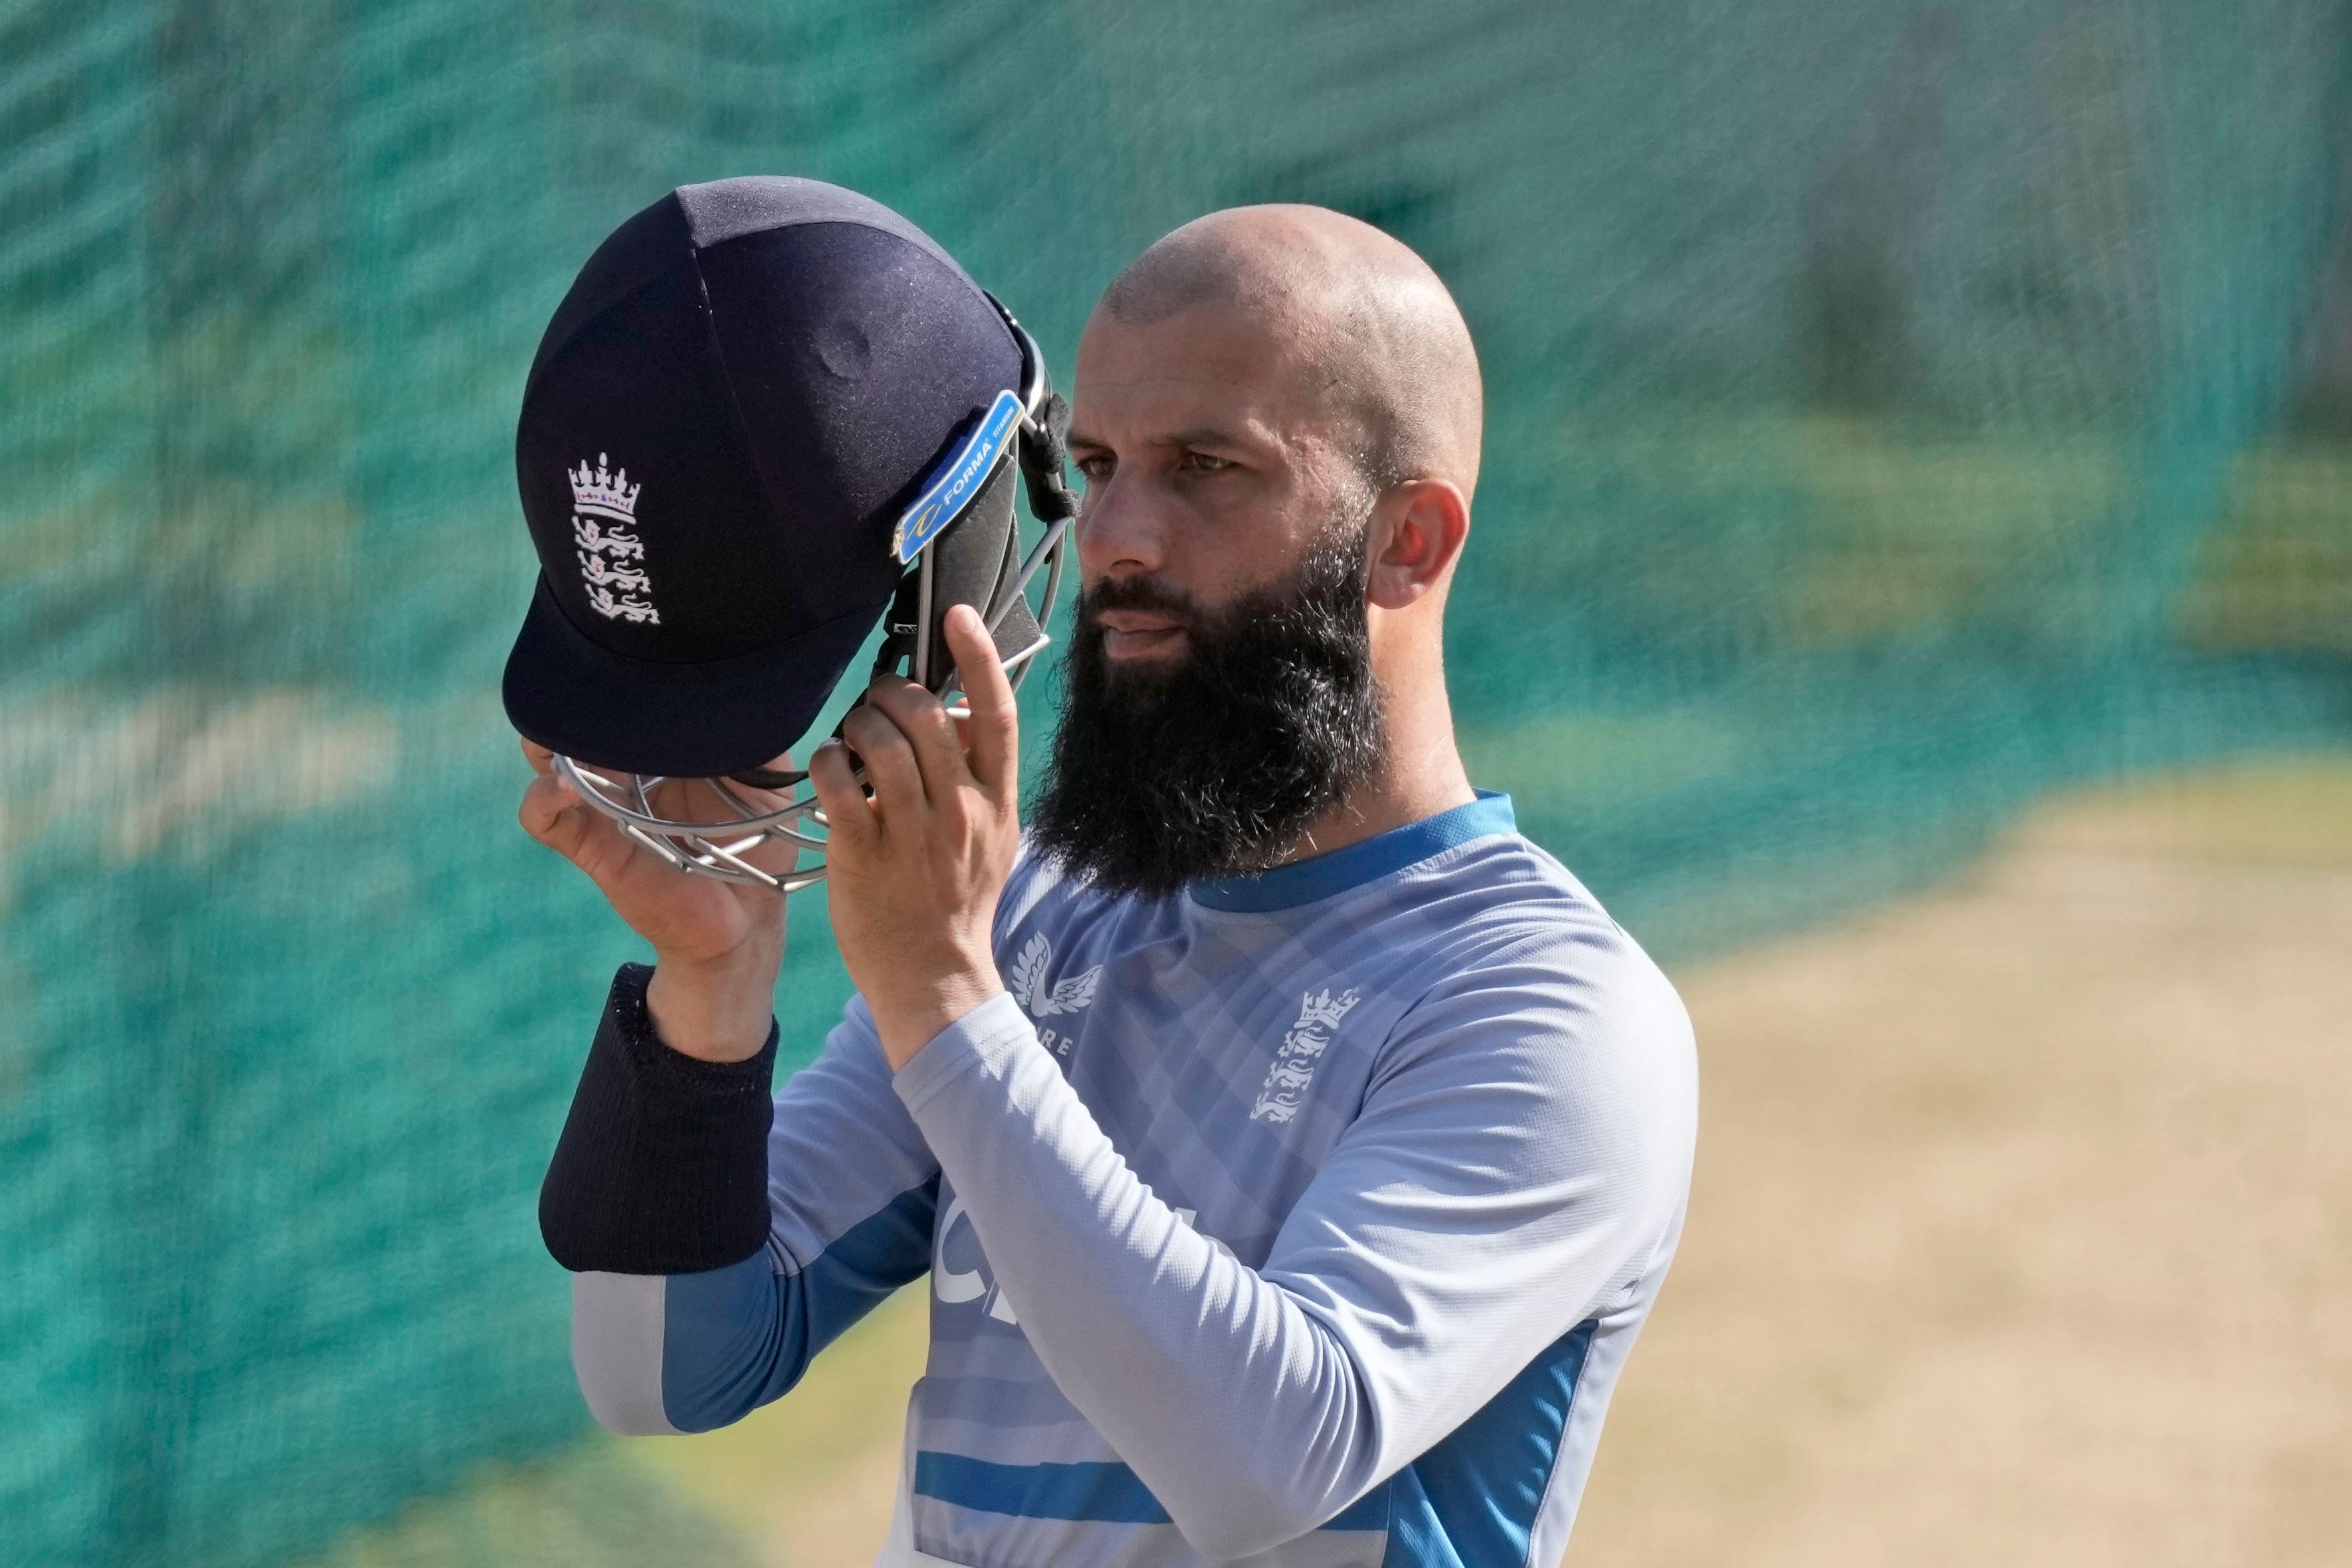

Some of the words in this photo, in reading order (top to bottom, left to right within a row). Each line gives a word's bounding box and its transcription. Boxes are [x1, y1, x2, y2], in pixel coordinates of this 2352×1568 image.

[944, 442, 992, 506] FORMA
[992, 405, 1014, 438] TITANIUM
[1037, 1026, 1073, 1056] RE
